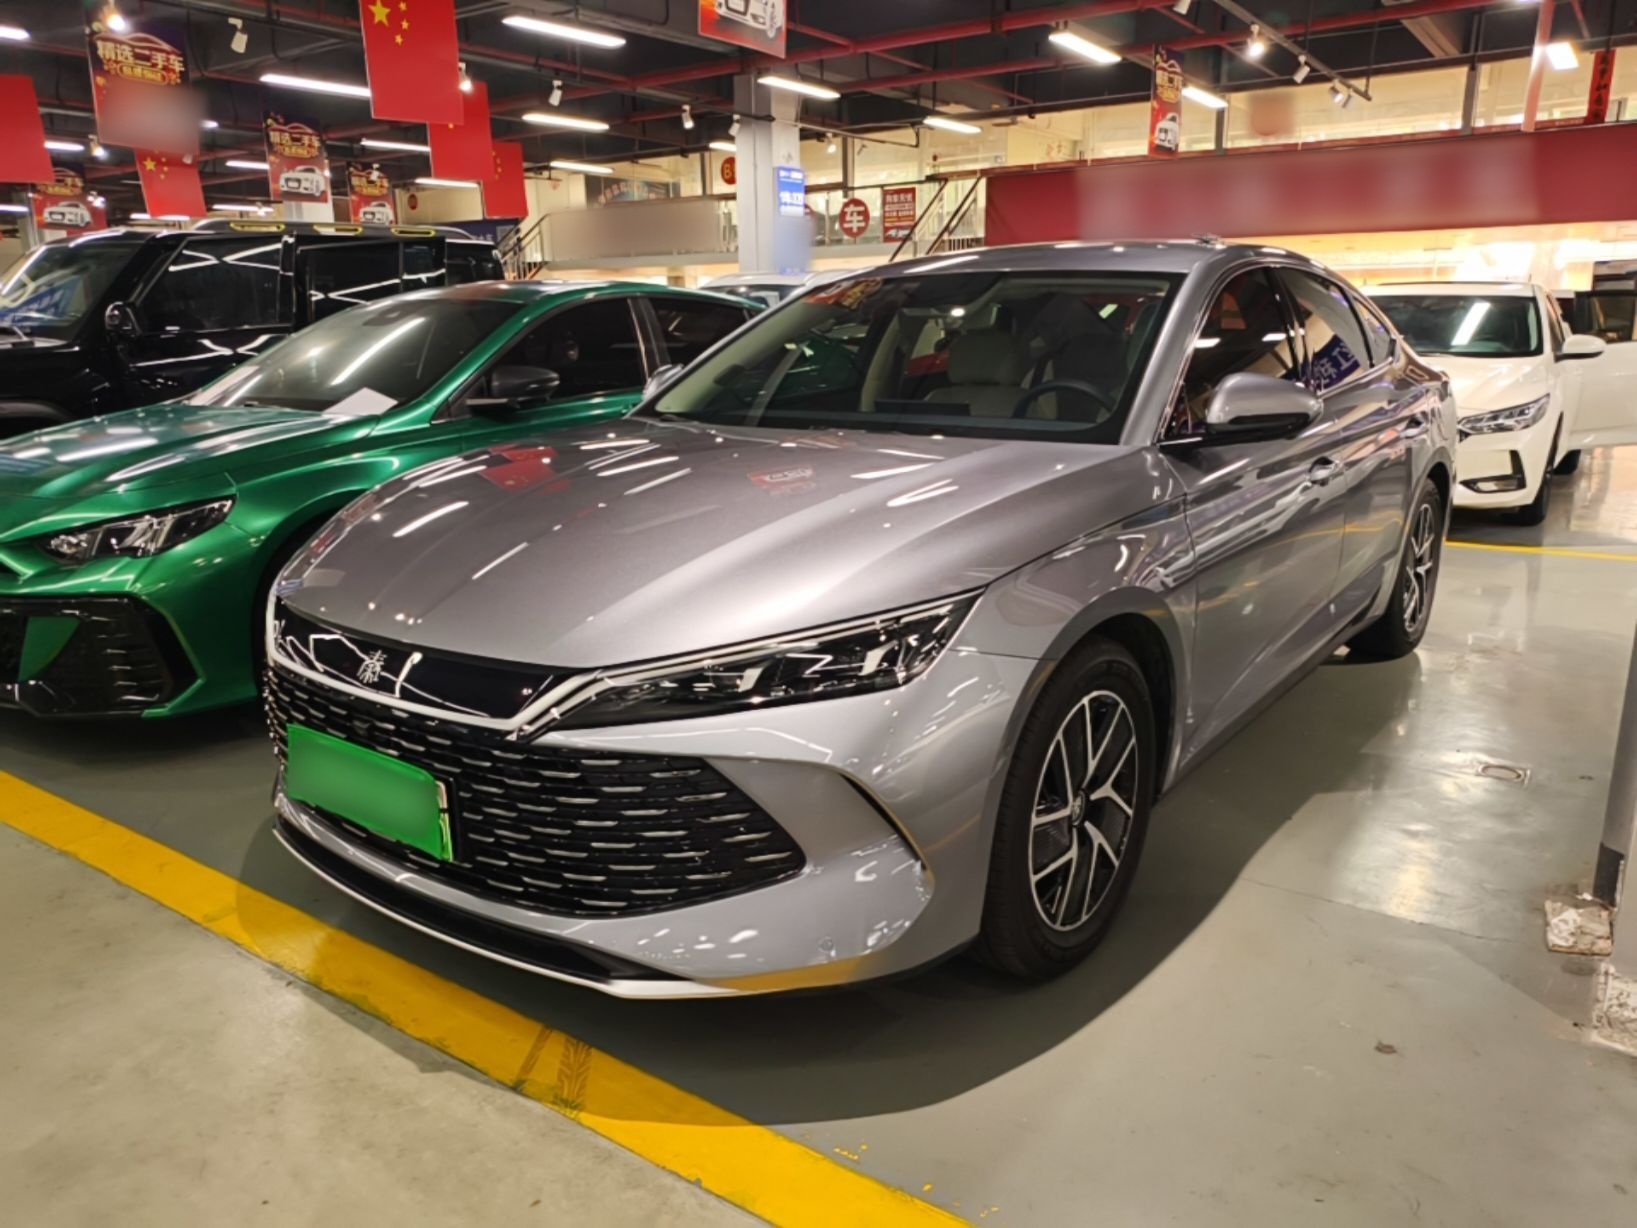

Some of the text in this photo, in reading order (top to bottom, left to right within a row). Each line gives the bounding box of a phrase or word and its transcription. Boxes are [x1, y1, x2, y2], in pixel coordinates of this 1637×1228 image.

[96, 40, 185, 77] 精选二手车
[843, 204, 866, 233] 车
